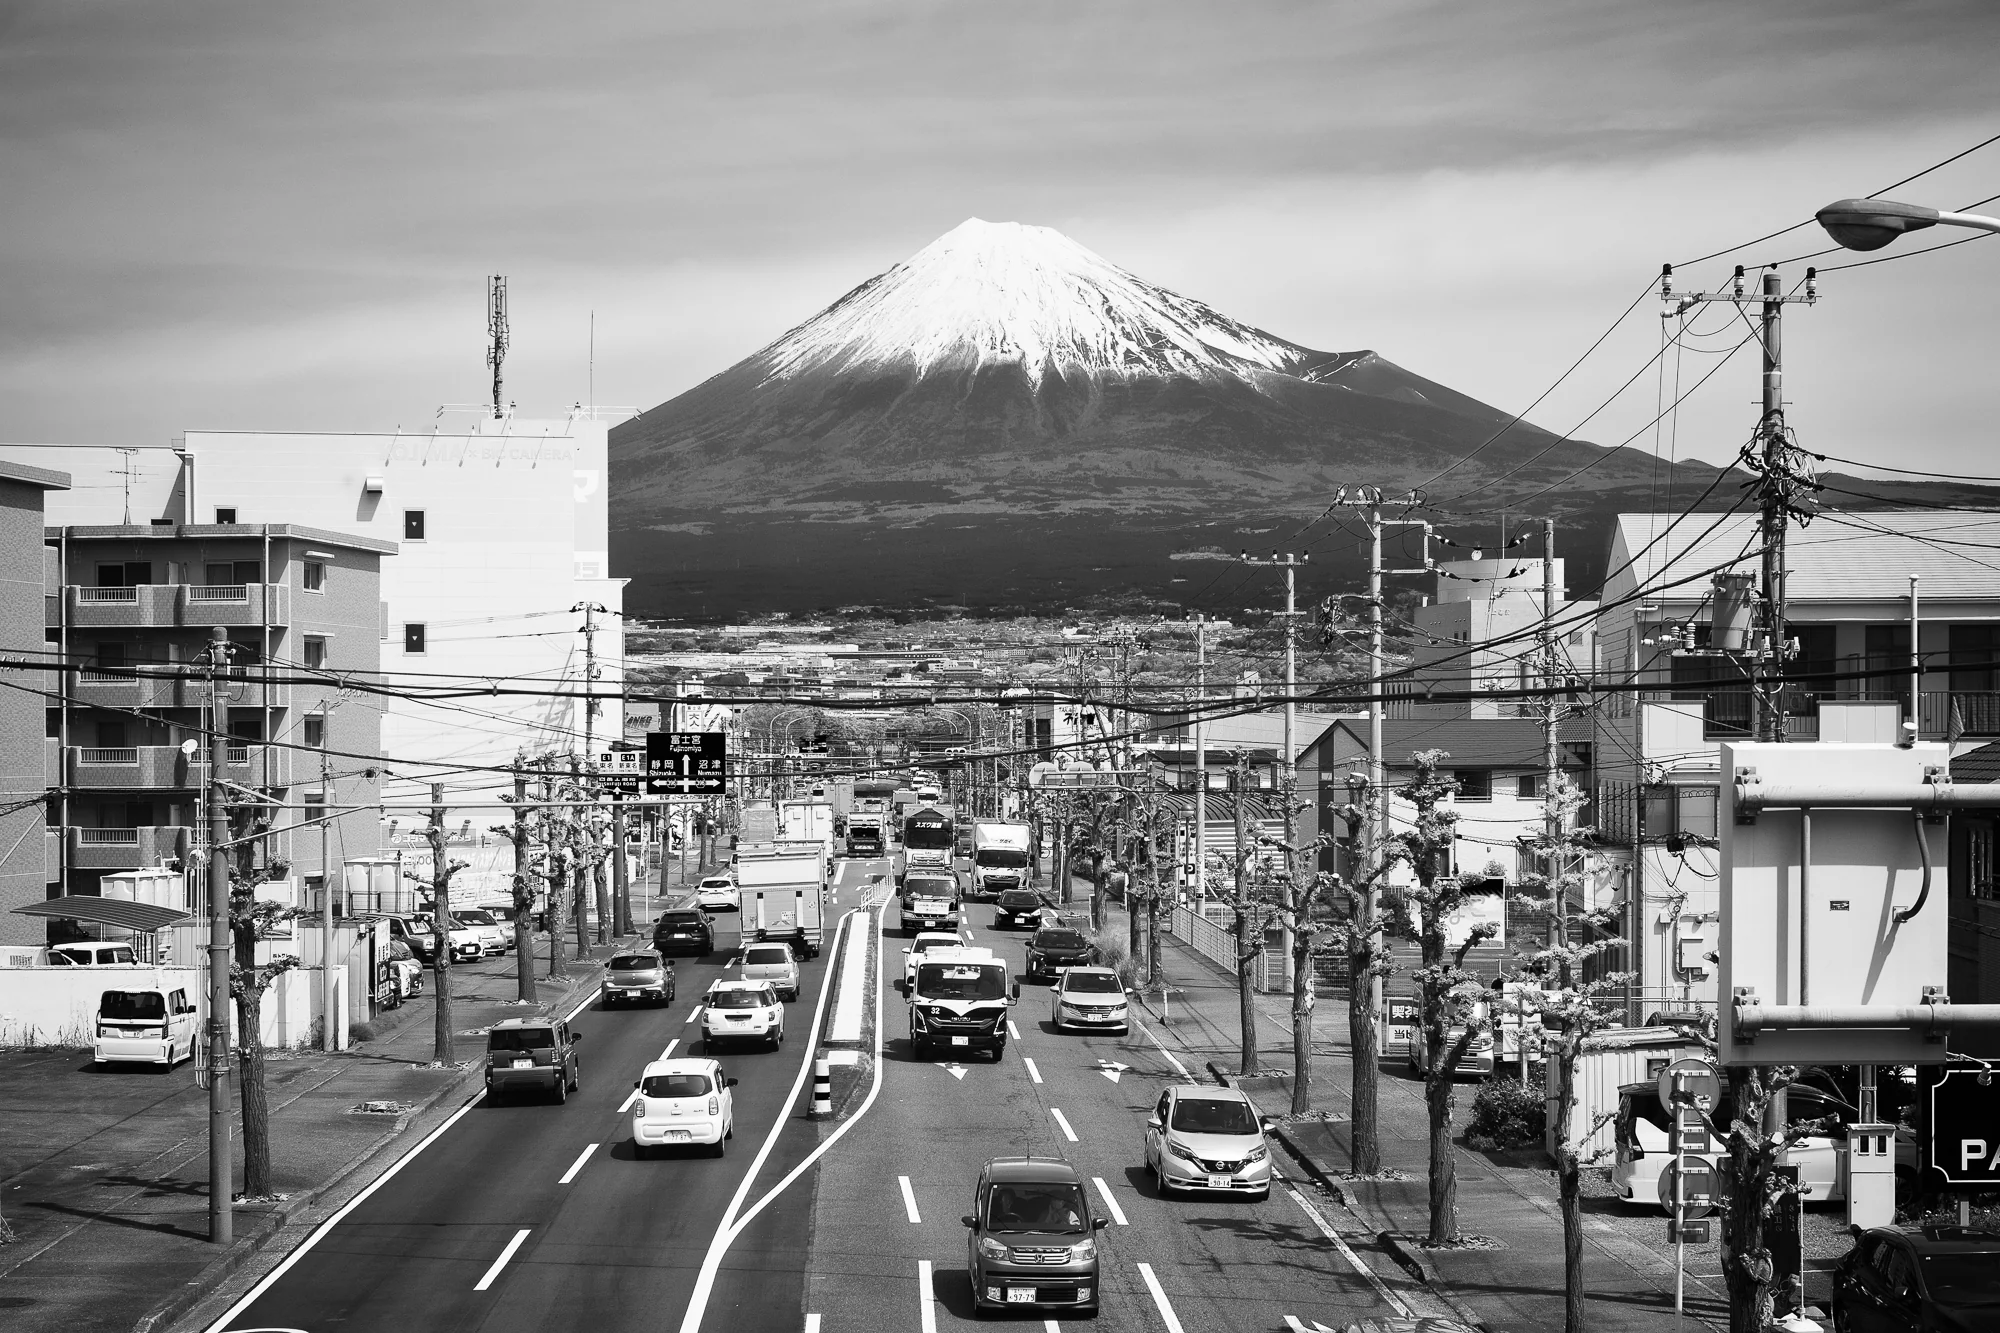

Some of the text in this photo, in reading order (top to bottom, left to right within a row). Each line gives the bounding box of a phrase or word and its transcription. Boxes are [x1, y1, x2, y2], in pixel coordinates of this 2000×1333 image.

[481, 448, 506, 460] BIC
[509, 448, 572, 460] CAMERA
[670, 735, 701, 745] 富士宮
[669, 745, 702, 753] Fujinomiya
[651, 759, 674, 769] 静岡
[698, 759, 721, 769] 沼津
[930, 1006, 940, 1015] 32
[1013, 1293, 1035, 1302] 97-79
